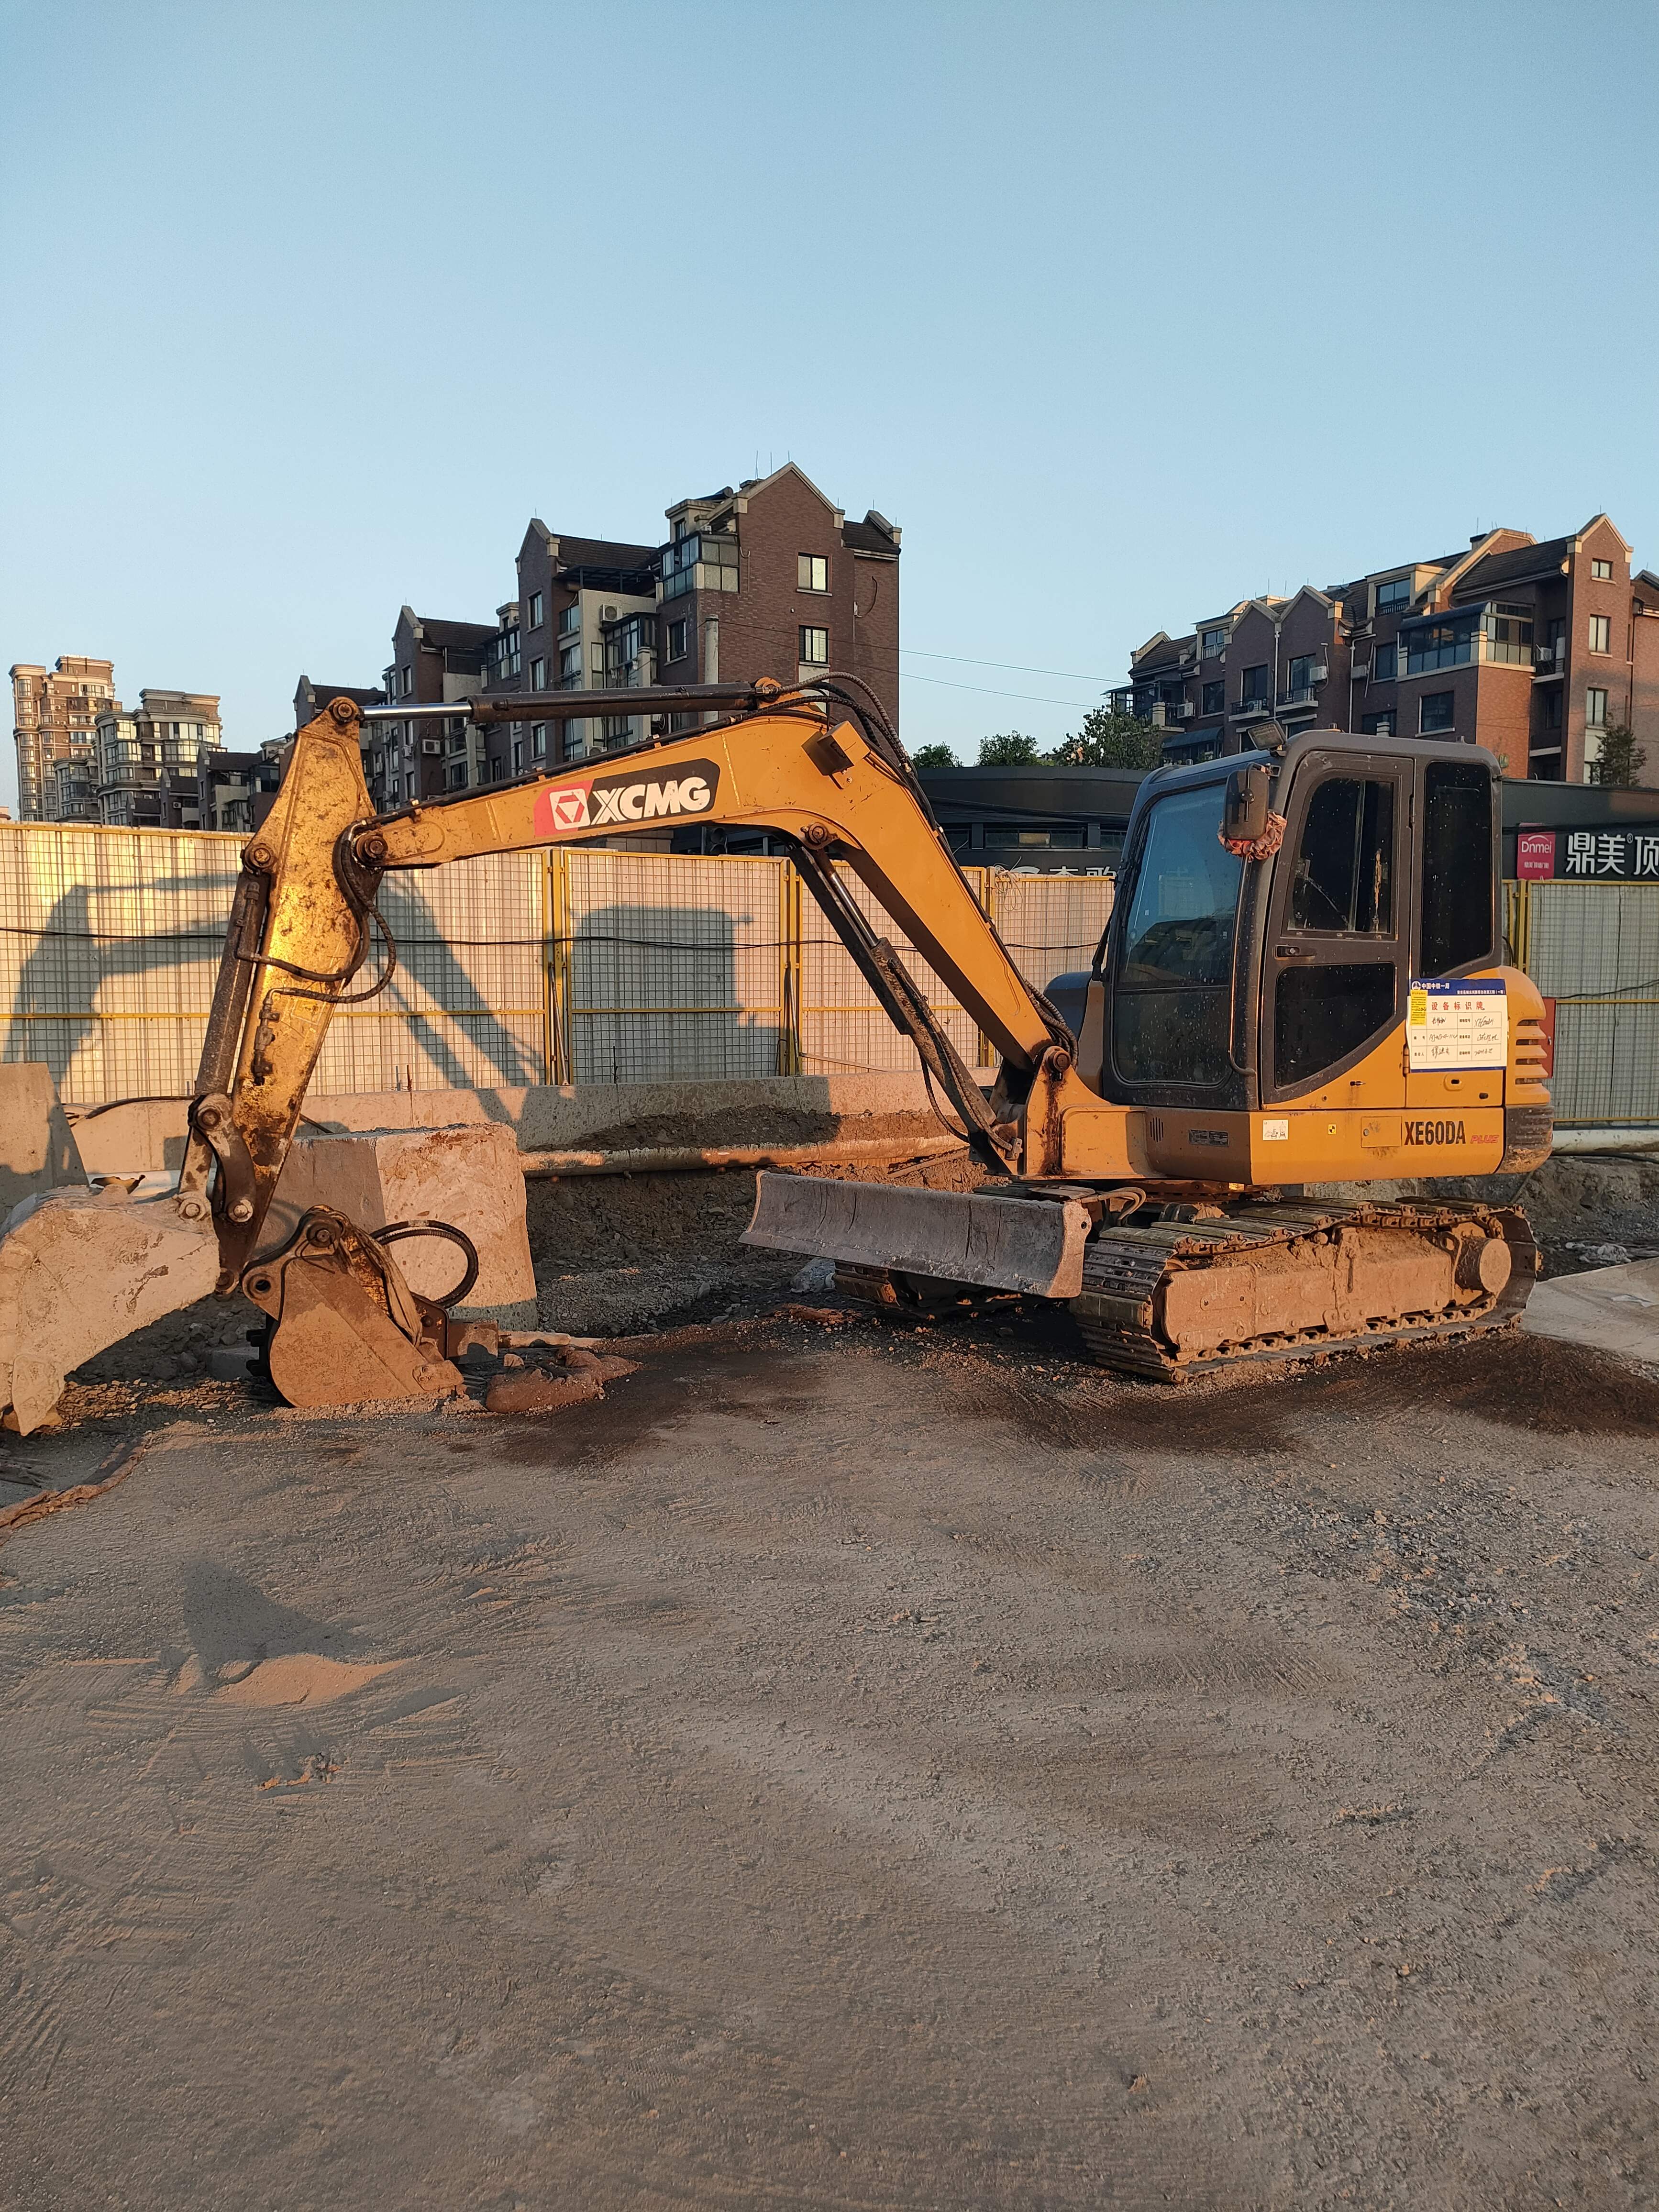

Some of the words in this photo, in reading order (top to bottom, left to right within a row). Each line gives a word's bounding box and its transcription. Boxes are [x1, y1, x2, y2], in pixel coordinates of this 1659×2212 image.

[592, 777, 710, 825] XCMG
[1521, 841, 1552, 854] Dnmei
[1431, 1002, 1483, 1011] 设备标识牌
[1405, 1121, 1466, 1145] XE60DA
[1470, 1135, 1500, 1144] PLUS
